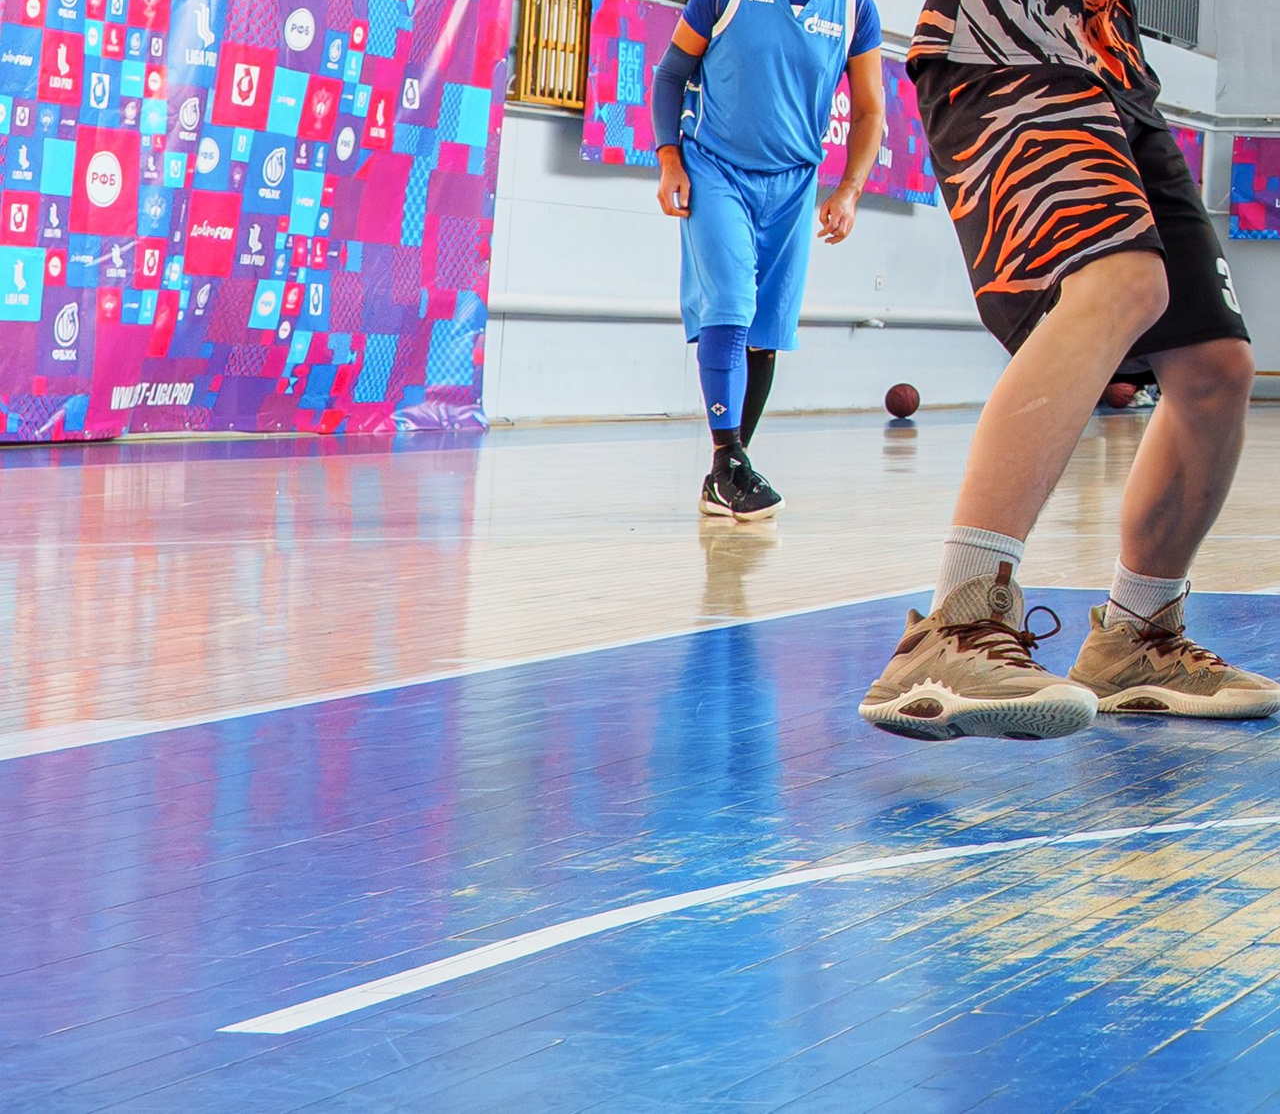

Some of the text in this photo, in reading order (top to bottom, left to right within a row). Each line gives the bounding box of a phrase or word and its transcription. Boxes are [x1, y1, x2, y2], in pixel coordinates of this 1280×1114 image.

[290, 23, 310, 36] РФБ
[618, 41, 641, 64] БАС
[618, 61, 639, 84] КЕТ
[617, 81, 640, 103] БОЛ
[91, 172, 116, 186] РФБ
